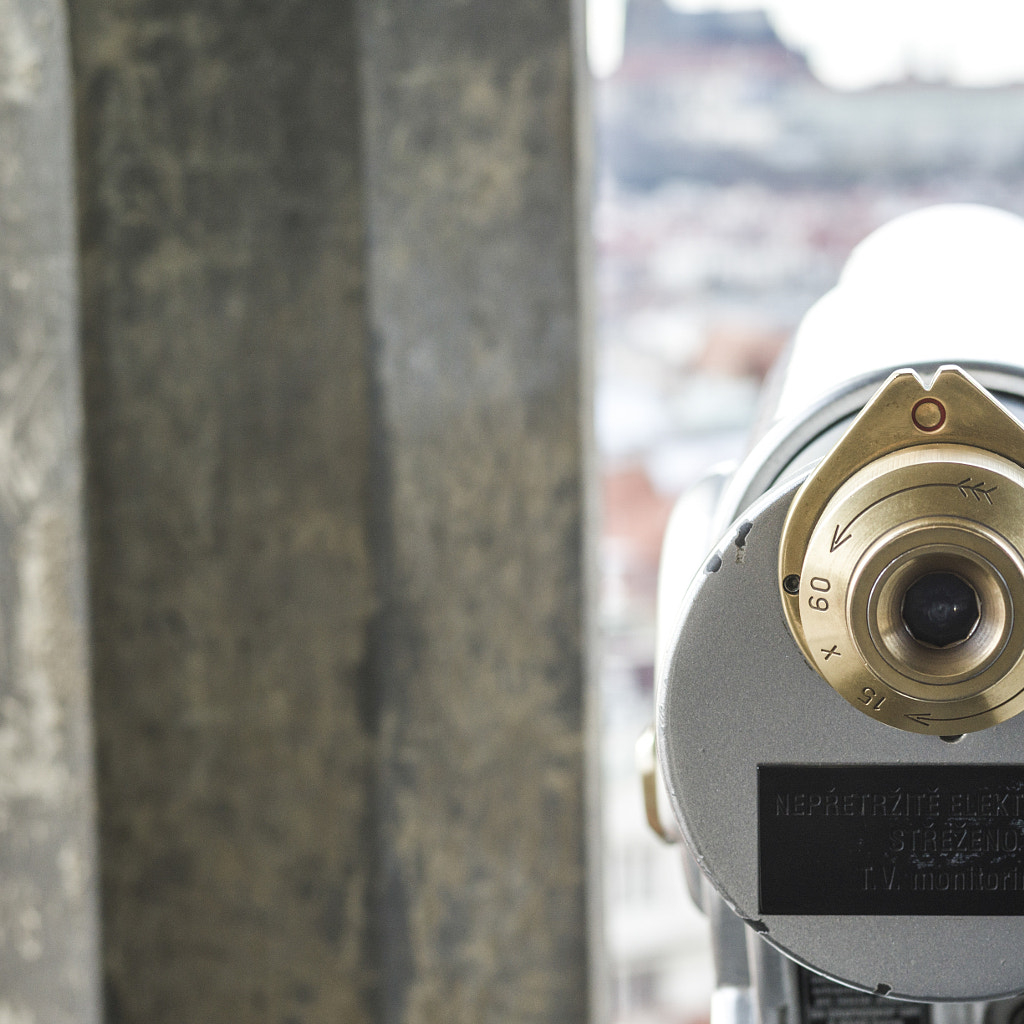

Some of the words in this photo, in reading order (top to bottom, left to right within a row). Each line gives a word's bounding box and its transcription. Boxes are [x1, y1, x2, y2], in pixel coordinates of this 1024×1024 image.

[808, 576, 831, 612] 60
[857, 687, 887, 711] 15
[775, 787, 941, 817] NEPŘETRŽITĚ
